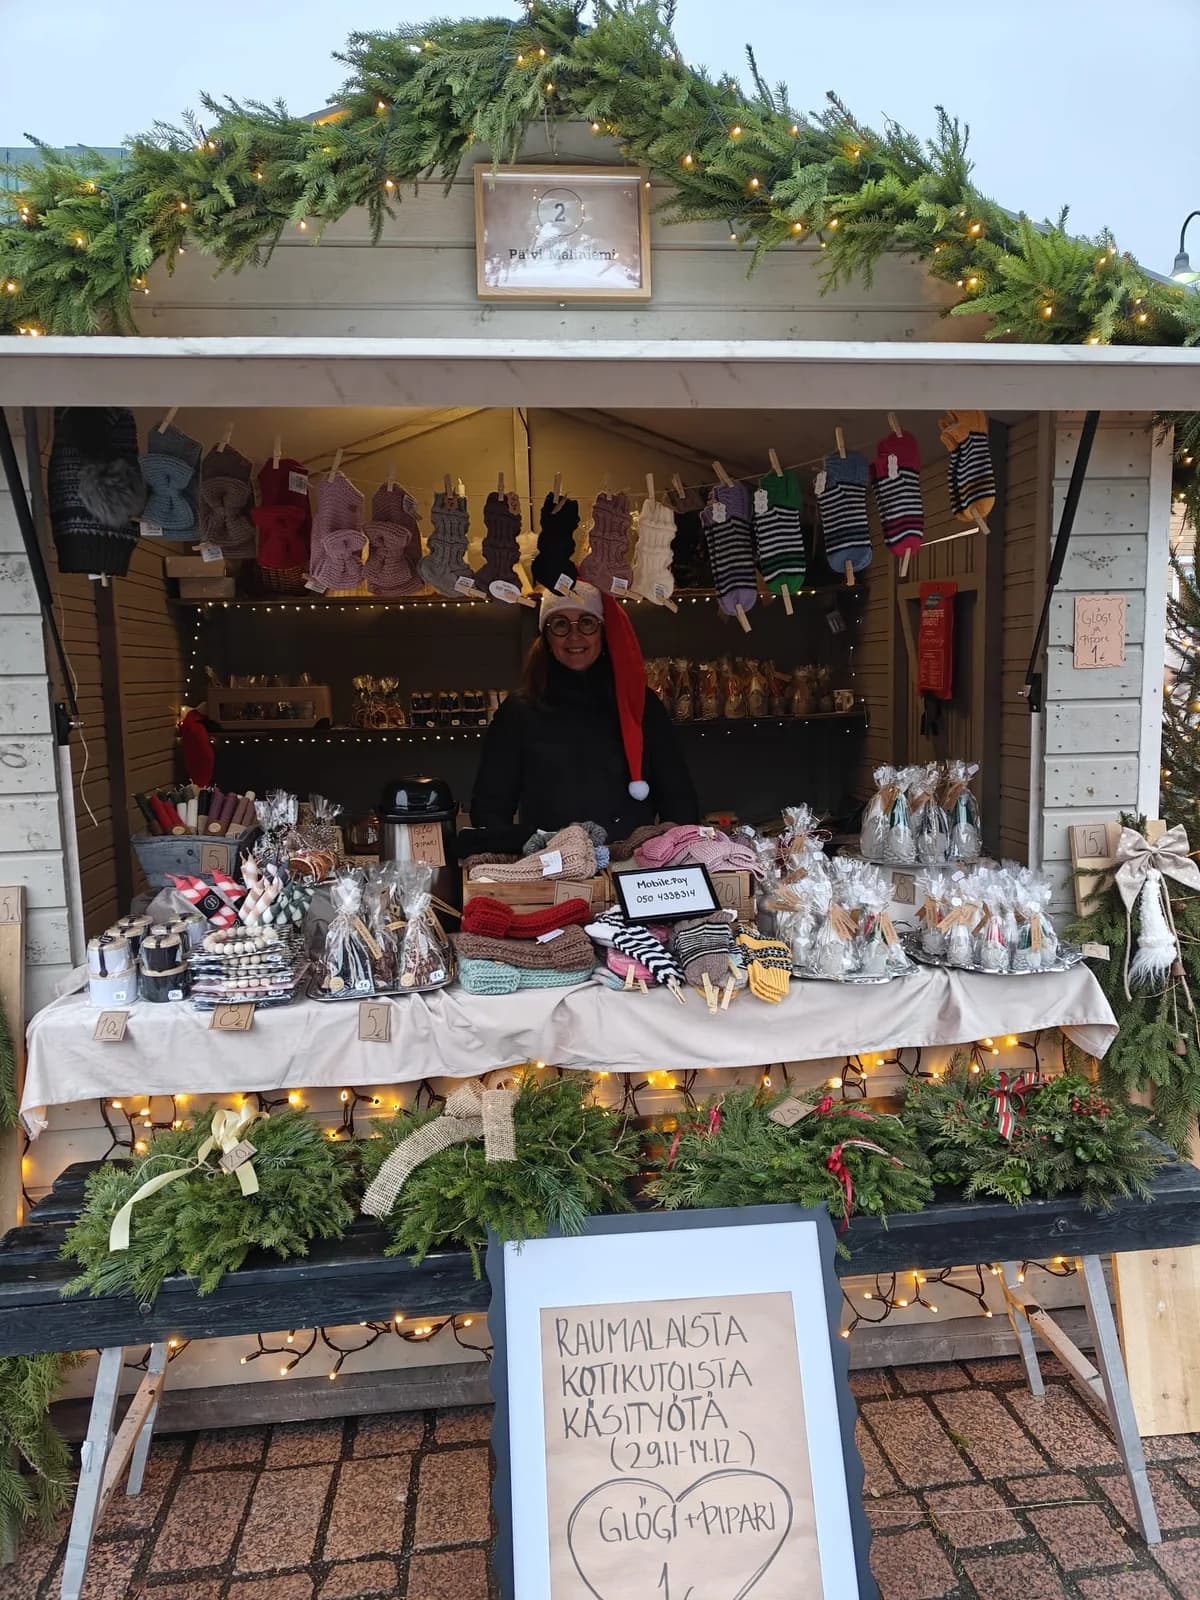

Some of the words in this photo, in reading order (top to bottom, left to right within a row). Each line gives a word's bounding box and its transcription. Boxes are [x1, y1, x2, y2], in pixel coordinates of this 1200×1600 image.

[553, 203, 566, 222] 2
[636, 895, 654, 903] 050
[657, 888, 696, 901] 4338314
[556, 1312, 748, 1357] RAUMALAISTA
[561, 1357, 753, 1398] KOTIKUTOISTA
[562, 1391, 729, 1439] KÄSITYÖTÄ
[599, 1496, 678, 1544] GLÖGI
